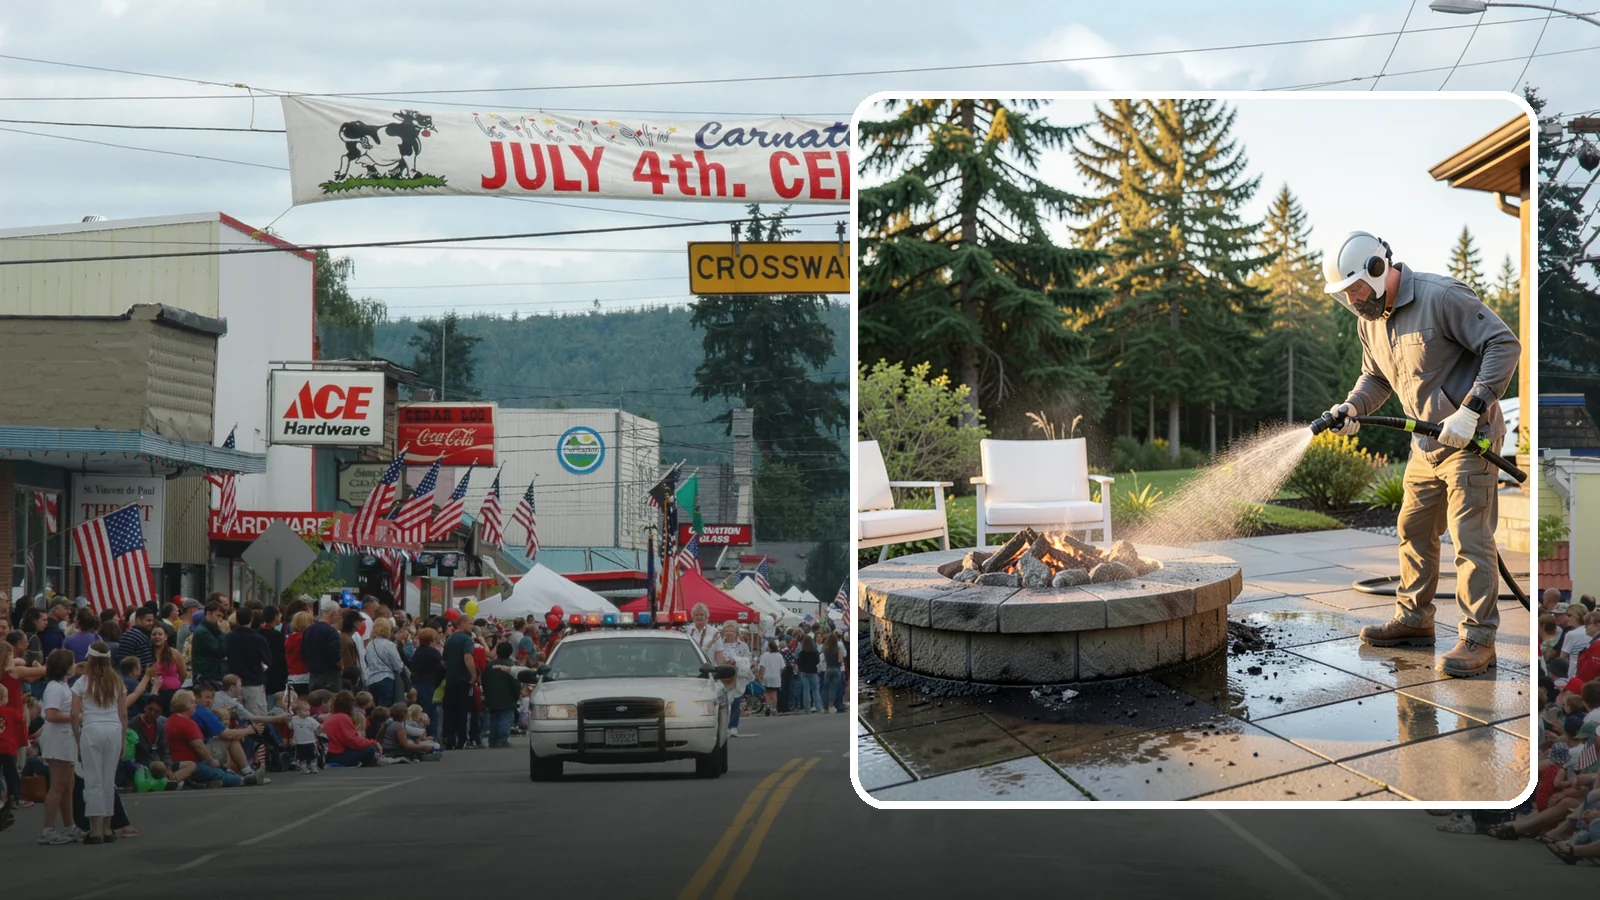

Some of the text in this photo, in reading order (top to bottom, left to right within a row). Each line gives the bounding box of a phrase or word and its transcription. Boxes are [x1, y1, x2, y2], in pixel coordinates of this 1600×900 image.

[481, 141, 605, 192] JULY
[632, 150, 746, 198] 4th.
[697, 254, 850, 280] CROSSWA
[282, 380, 374, 420] ACE
[405, 409, 453, 422] CEDAR
[283, 421, 371, 436] Hardware
[416, 428, 477, 447] Coca-Cola
[353, 467, 384, 480] Simpl
[96, 485, 124, 495] Vincent
[126, 486, 136, 495] de
[137, 486, 155, 495] Paul
[688, 526, 741, 535] CRNATION
[699, 535, 730, 543] GLASS
